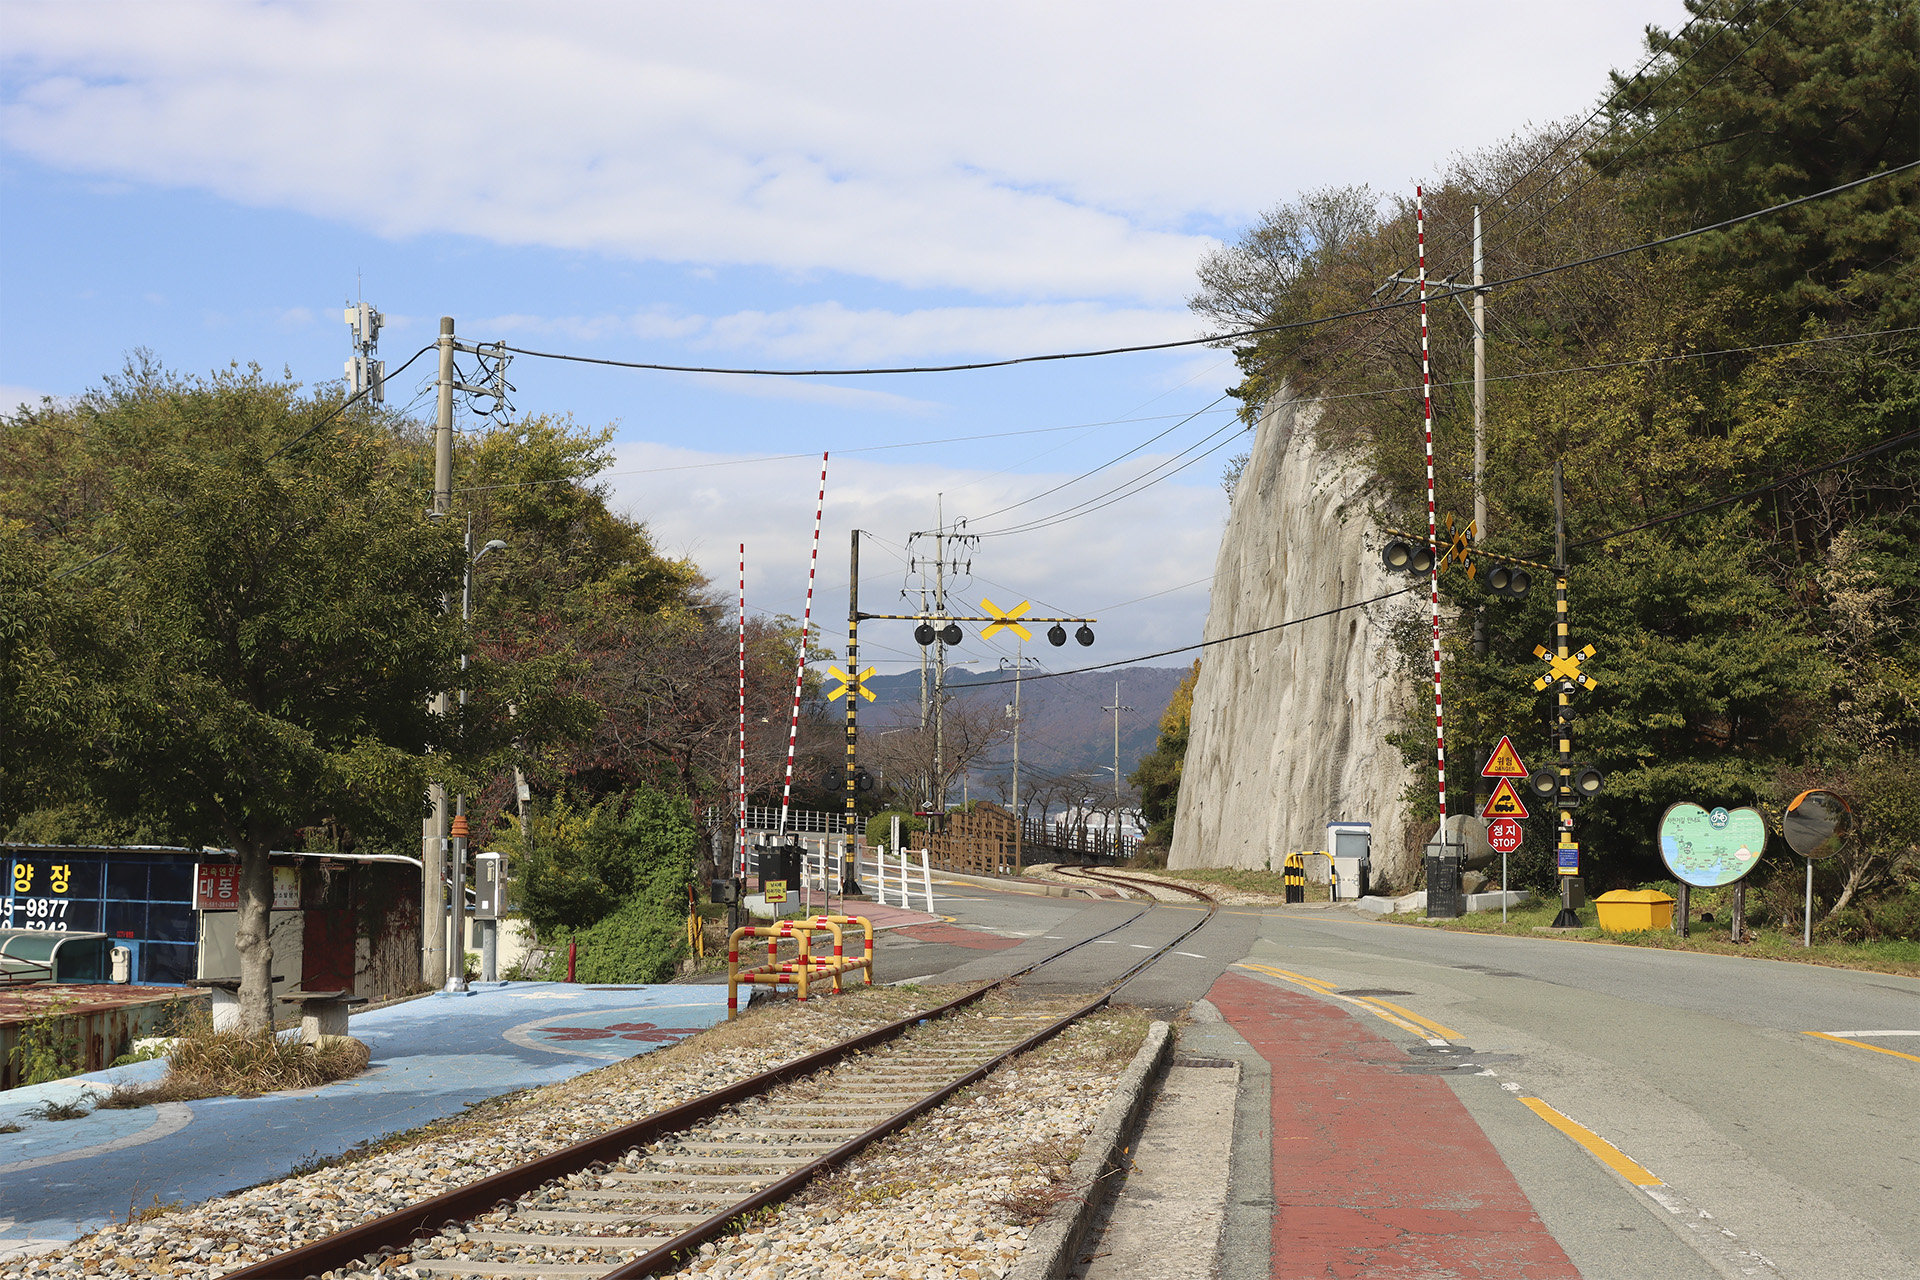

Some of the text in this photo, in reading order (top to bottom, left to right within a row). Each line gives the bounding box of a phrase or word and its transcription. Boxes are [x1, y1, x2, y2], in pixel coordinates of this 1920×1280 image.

[1497, 756, 1513, 766] 위험
[1492, 824, 1516, 837] 정지
[1492, 838, 1516, 847] STOP
[199, 878, 240, 899] 대동
